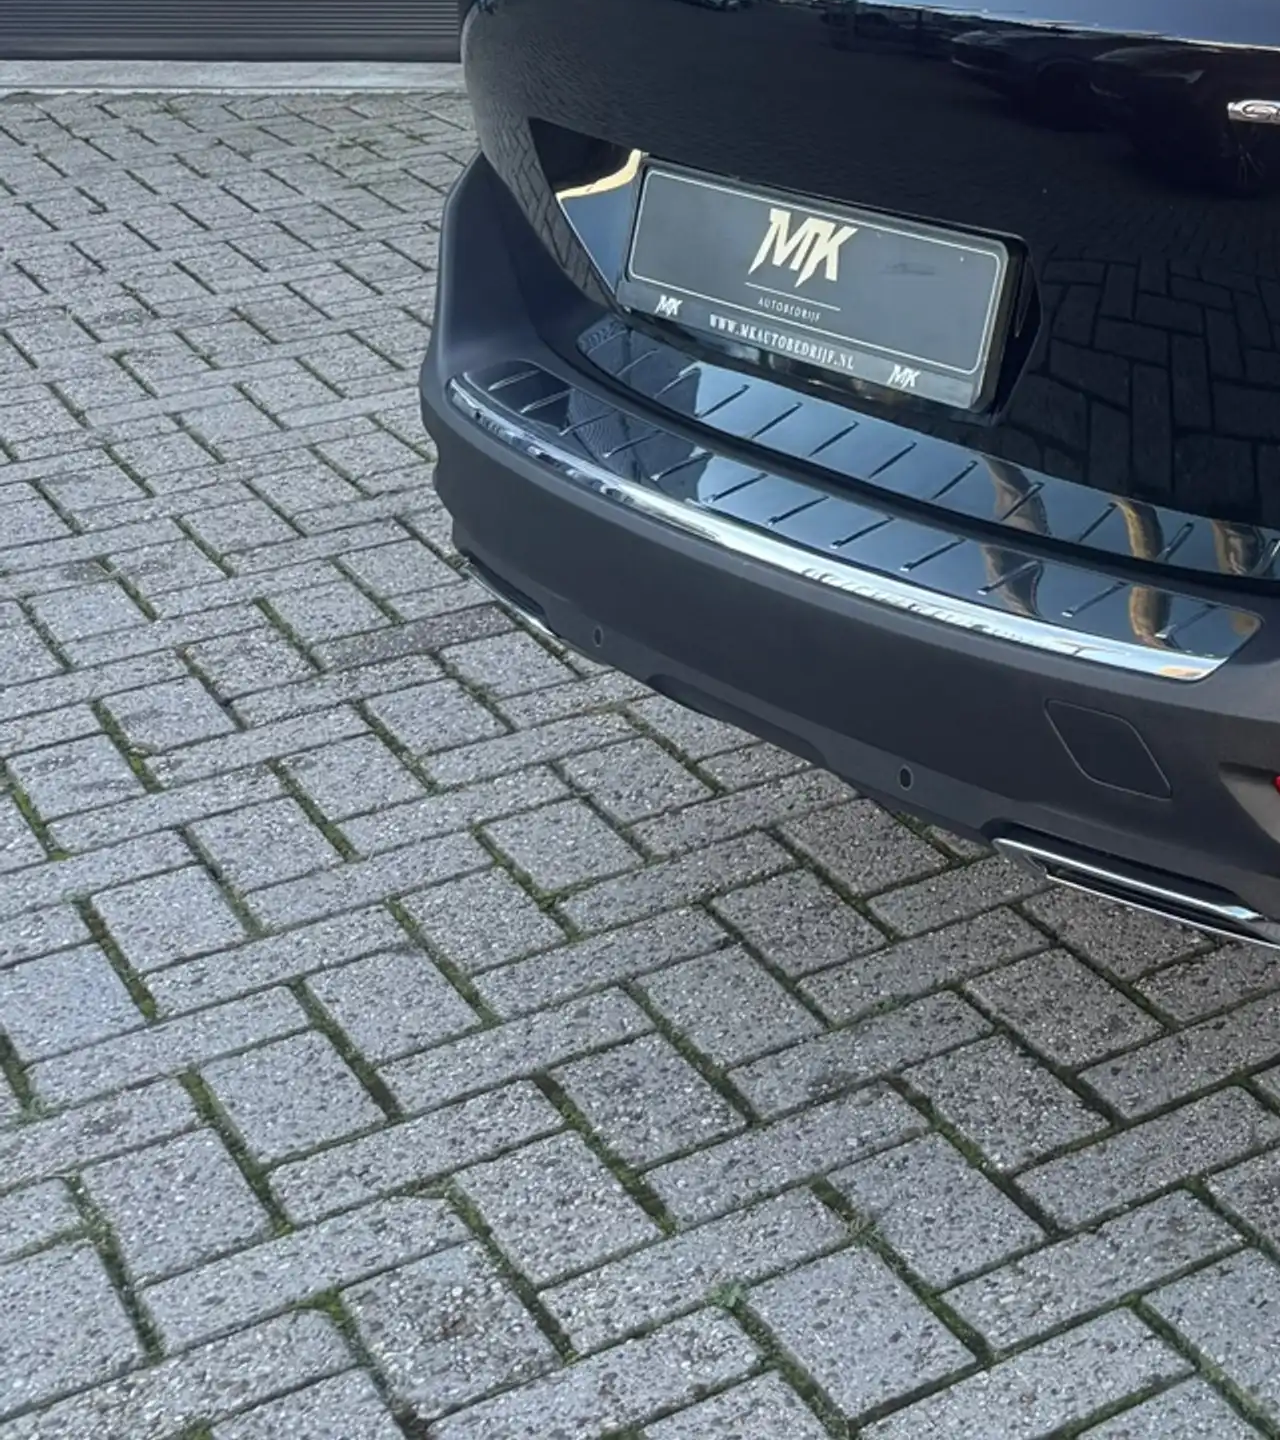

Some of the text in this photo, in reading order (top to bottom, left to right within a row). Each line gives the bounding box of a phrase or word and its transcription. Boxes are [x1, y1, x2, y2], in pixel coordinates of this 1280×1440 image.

[748, 207, 858, 288] MK
[654, 293, 684, 317] MK
[757, 296, 822, 323] AUTOBEDRIJF
[709, 313, 855, 371] WWW.MKAUTOBEDRIJF.NL
[885, 363, 921, 390] MK
